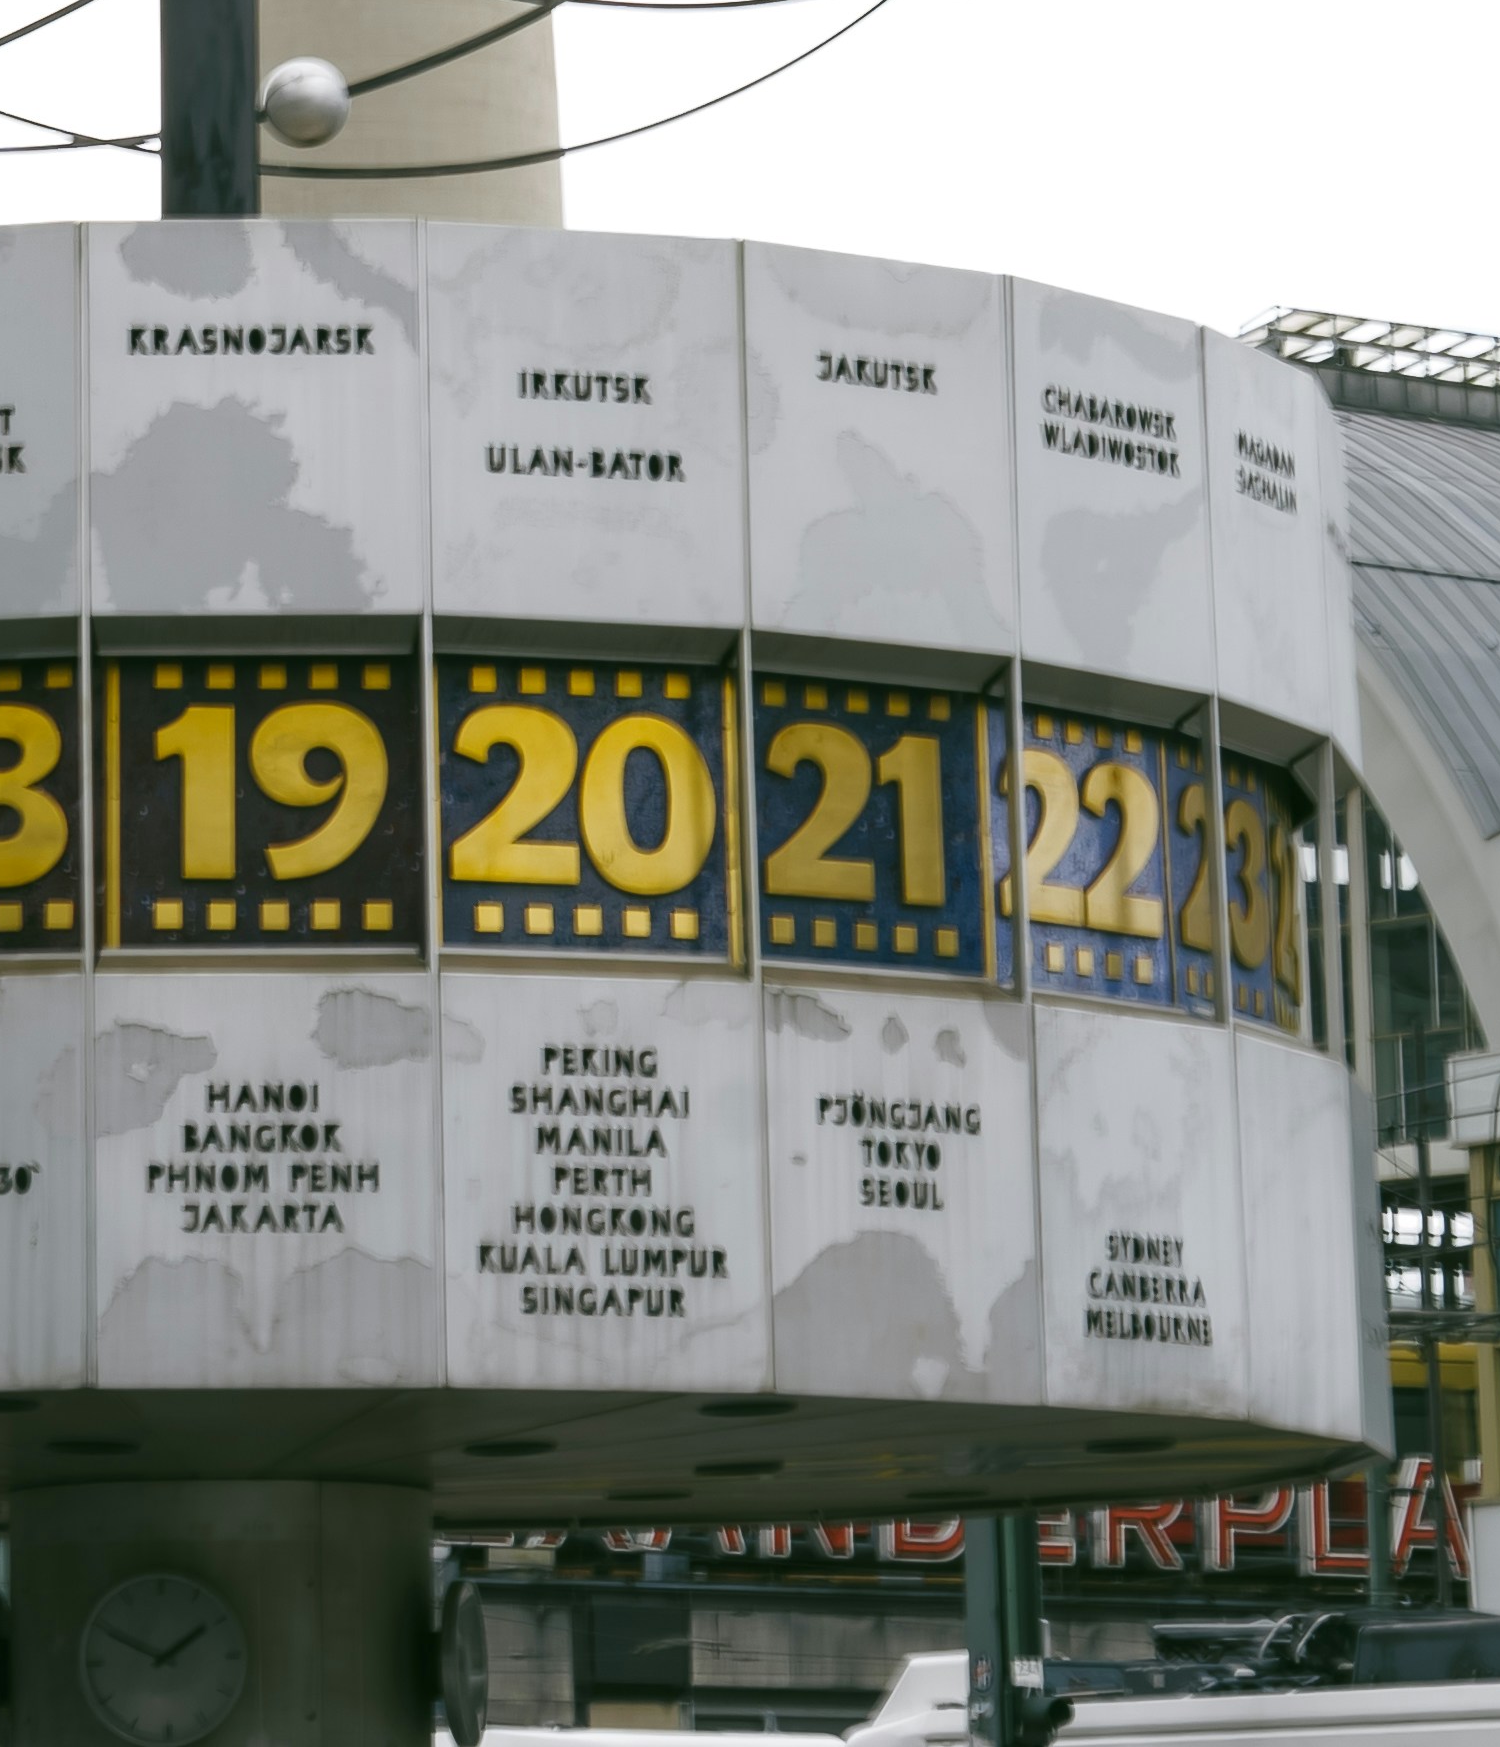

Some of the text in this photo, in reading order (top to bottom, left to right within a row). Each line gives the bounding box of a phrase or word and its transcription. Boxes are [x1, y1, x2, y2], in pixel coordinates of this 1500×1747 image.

[126, 322, 376, 355] KRASNOJARSK
[517, 367, 653, 406] IRKUTSK
[815, 349, 938, 395] JAKUTSK
[1040, 381, 1177, 443] CHABAROWSK
[484, 443, 686, 483] ULAN-BATOR
[1040, 419, 1181, 479] WLADIWOSTOK
[154, 700, 390, 881] 19
[450, 702, 717, 896] 20
[765, 723, 946, 908] 21
[999, 747, 1164, 939] 22
[1178, 784, 1270, 969] 23
[540, 1044, 658, 1079] PEKING
[204, 1081, 319, 1114] HANOI
[509, 1083, 690, 1119] SHANGHAI
[817, 1090, 982, 1135] PJÖNGJANG
[179, 1120, 344, 1154] BANGKOK
[535, 1124, 667, 1158] MANILA
[859, 1136, 942, 1173] TOKYO
[145, 1162, 380, 1194] PHNOM PENH
[550, 1165, 652, 1198] PERTH
[859, 1177, 944, 1211] SEOUL
[180, 1201, 345, 1234] JAKARTA
[511, 1203, 695, 1236] HONGKONG
[477, 1242, 729, 1280] KUALA LUMPUR
[1105, 1229, 1183, 1269] SYDNEY
[520, 1283, 687, 1318] SINGAPUR
[1086, 1267, 1206, 1308] CANBERRA
[1083, 1306, 1213, 1347] MELBOURNE
